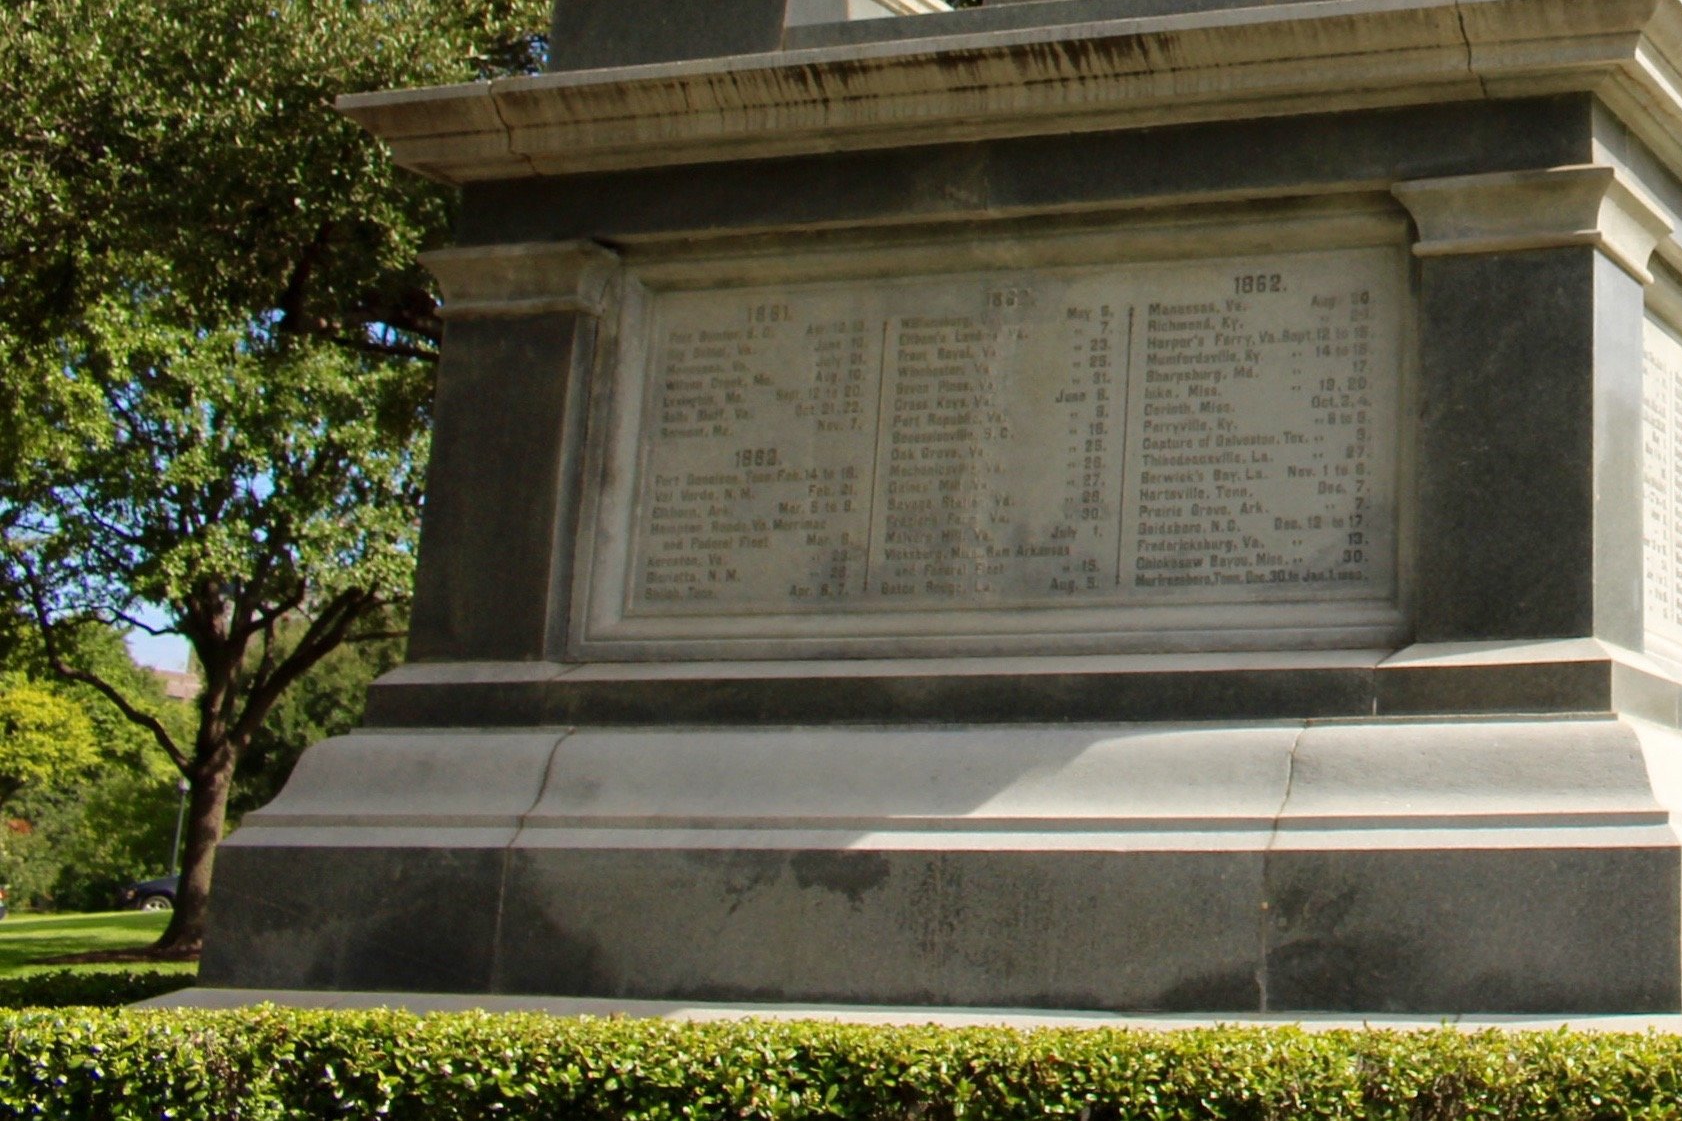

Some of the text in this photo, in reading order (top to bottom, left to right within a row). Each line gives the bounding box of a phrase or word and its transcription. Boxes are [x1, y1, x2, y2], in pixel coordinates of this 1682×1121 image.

[1234, 274, 1287, 294] 1862.
[1067, 307, 1092, 322] May
[1315, 344, 1331, 357] 14
[1335, 345, 1349, 357] to
[1054, 388, 1086, 403] June
[893, 415, 920, 428] Port
[1142, 437, 1193, 451] Capture
[1198, 435, 1210, 449] of
[891, 448, 914, 461] Oak
[1323, 463, 1329, 477] 1
[1335, 464, 1348, 477] to
[1083, 472, 1105, 487] 27.
[1355, 479, 1371, 493] 7.
[1138, 504, 1182, 519] Prairie
[1355, 496, 1371, 510] 7.
[662, 539, 683, 550] and
[691, 537, 733, 550] Federal
[1242, 535, 1265, 549] Va.
[1015, 544, 1070, 557] Arkansas
[1135, 556, 1203, 570] Chickasaw
[1343, 549, 1369, 564] 30.
